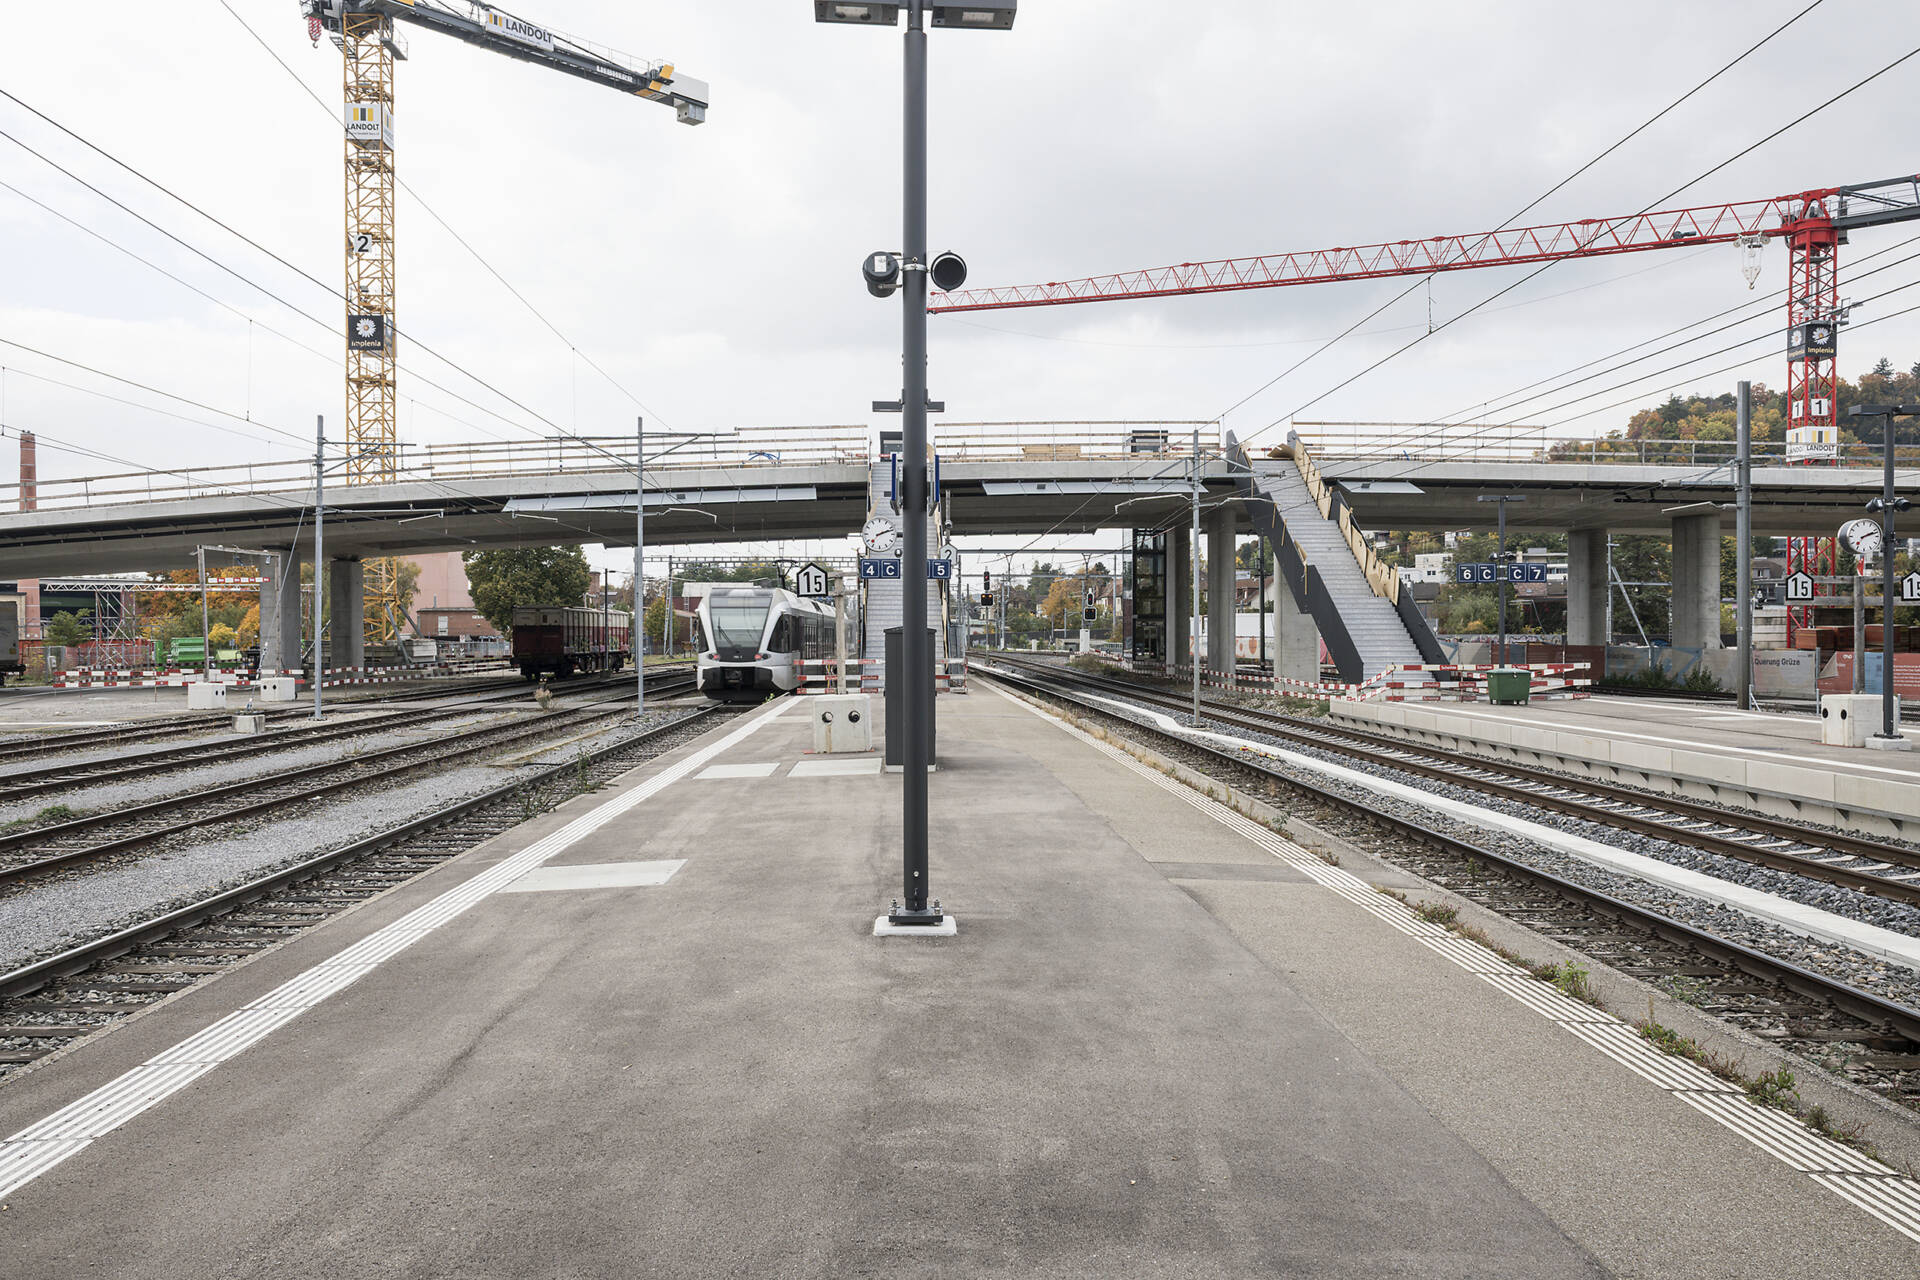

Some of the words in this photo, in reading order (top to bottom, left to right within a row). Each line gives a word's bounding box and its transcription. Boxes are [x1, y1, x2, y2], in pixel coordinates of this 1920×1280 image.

[506, 18, 552, 44] LANDOLT
[346, 123, 379, 131] LANDOLT
[357, 235, 369, 252] 2
[1807, 346, 1835, 354] Implenia
[1794, 402, 1800, 417] 1
[1815, 399, 1822, 415] 1
[1806, 443, 1835, 452] LANDOLT
[866, 565, 875, 576] 4
[886, 565, 895, 576] C
[937, 565, 945, 576] 5
[1463, 569, 1472, 580] 6
[1482, 569, 1491, 580] C
[1513, 569, 1522, 579] C
[1533, 569, 1541, 580] 7
[803, 571, 823, 593] 15
[1791, 577, 1808, 597] 15
